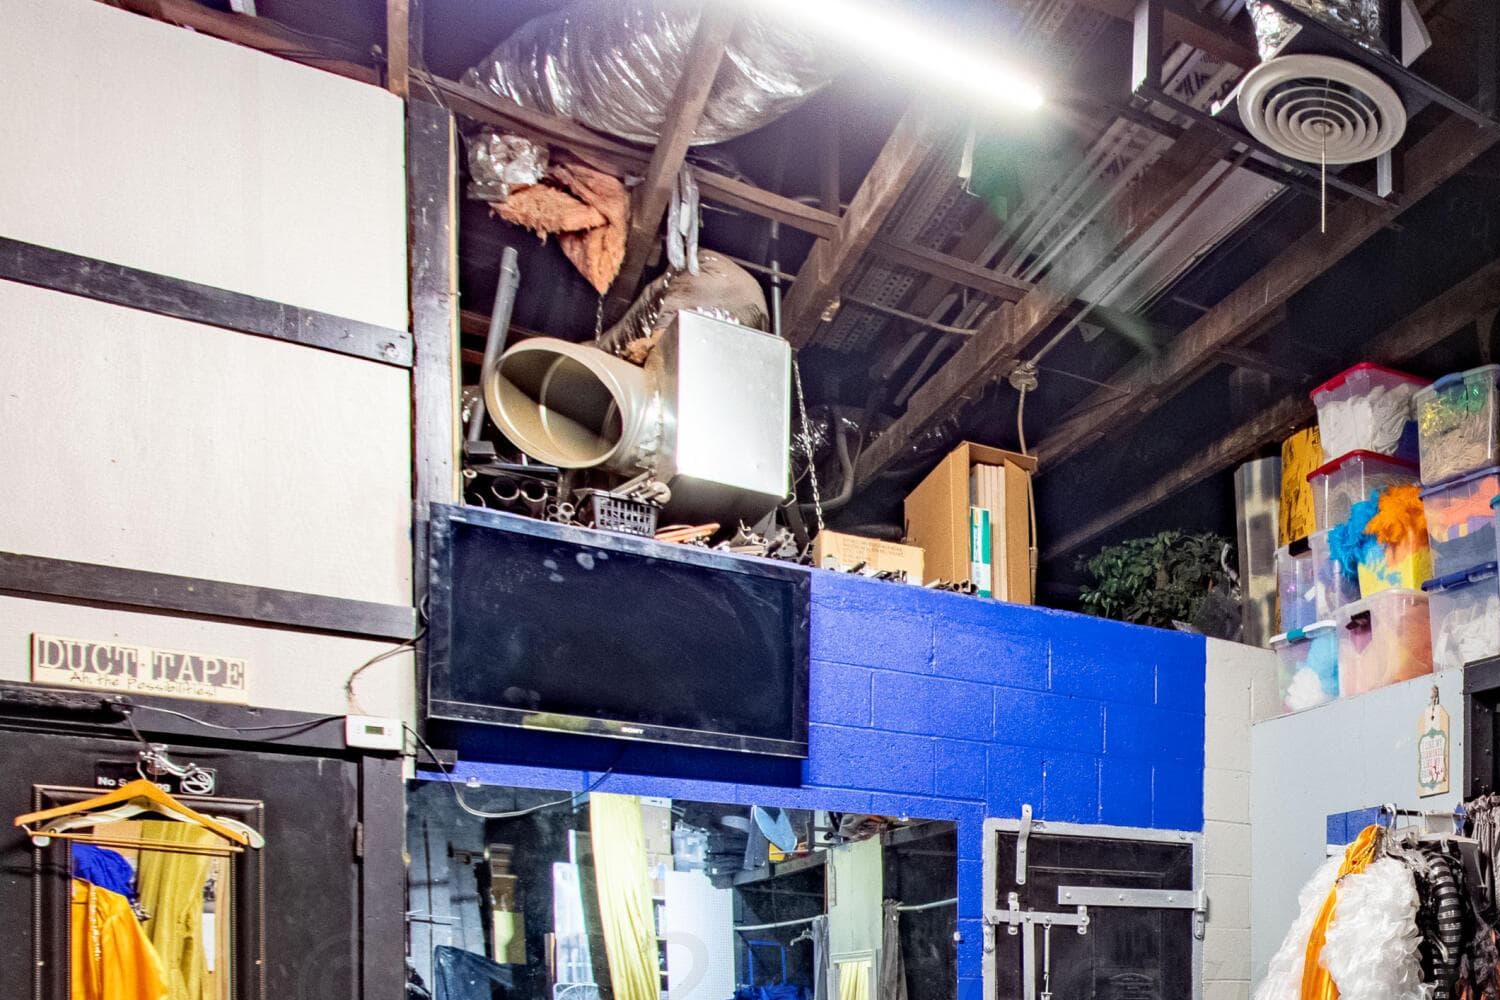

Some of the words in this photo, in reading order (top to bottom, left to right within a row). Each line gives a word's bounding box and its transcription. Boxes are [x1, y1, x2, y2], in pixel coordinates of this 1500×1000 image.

[39, 638, 137, 677] DUCT
[153, 651, 244, 688] TAPE
[97, 777, 116, 786] No
